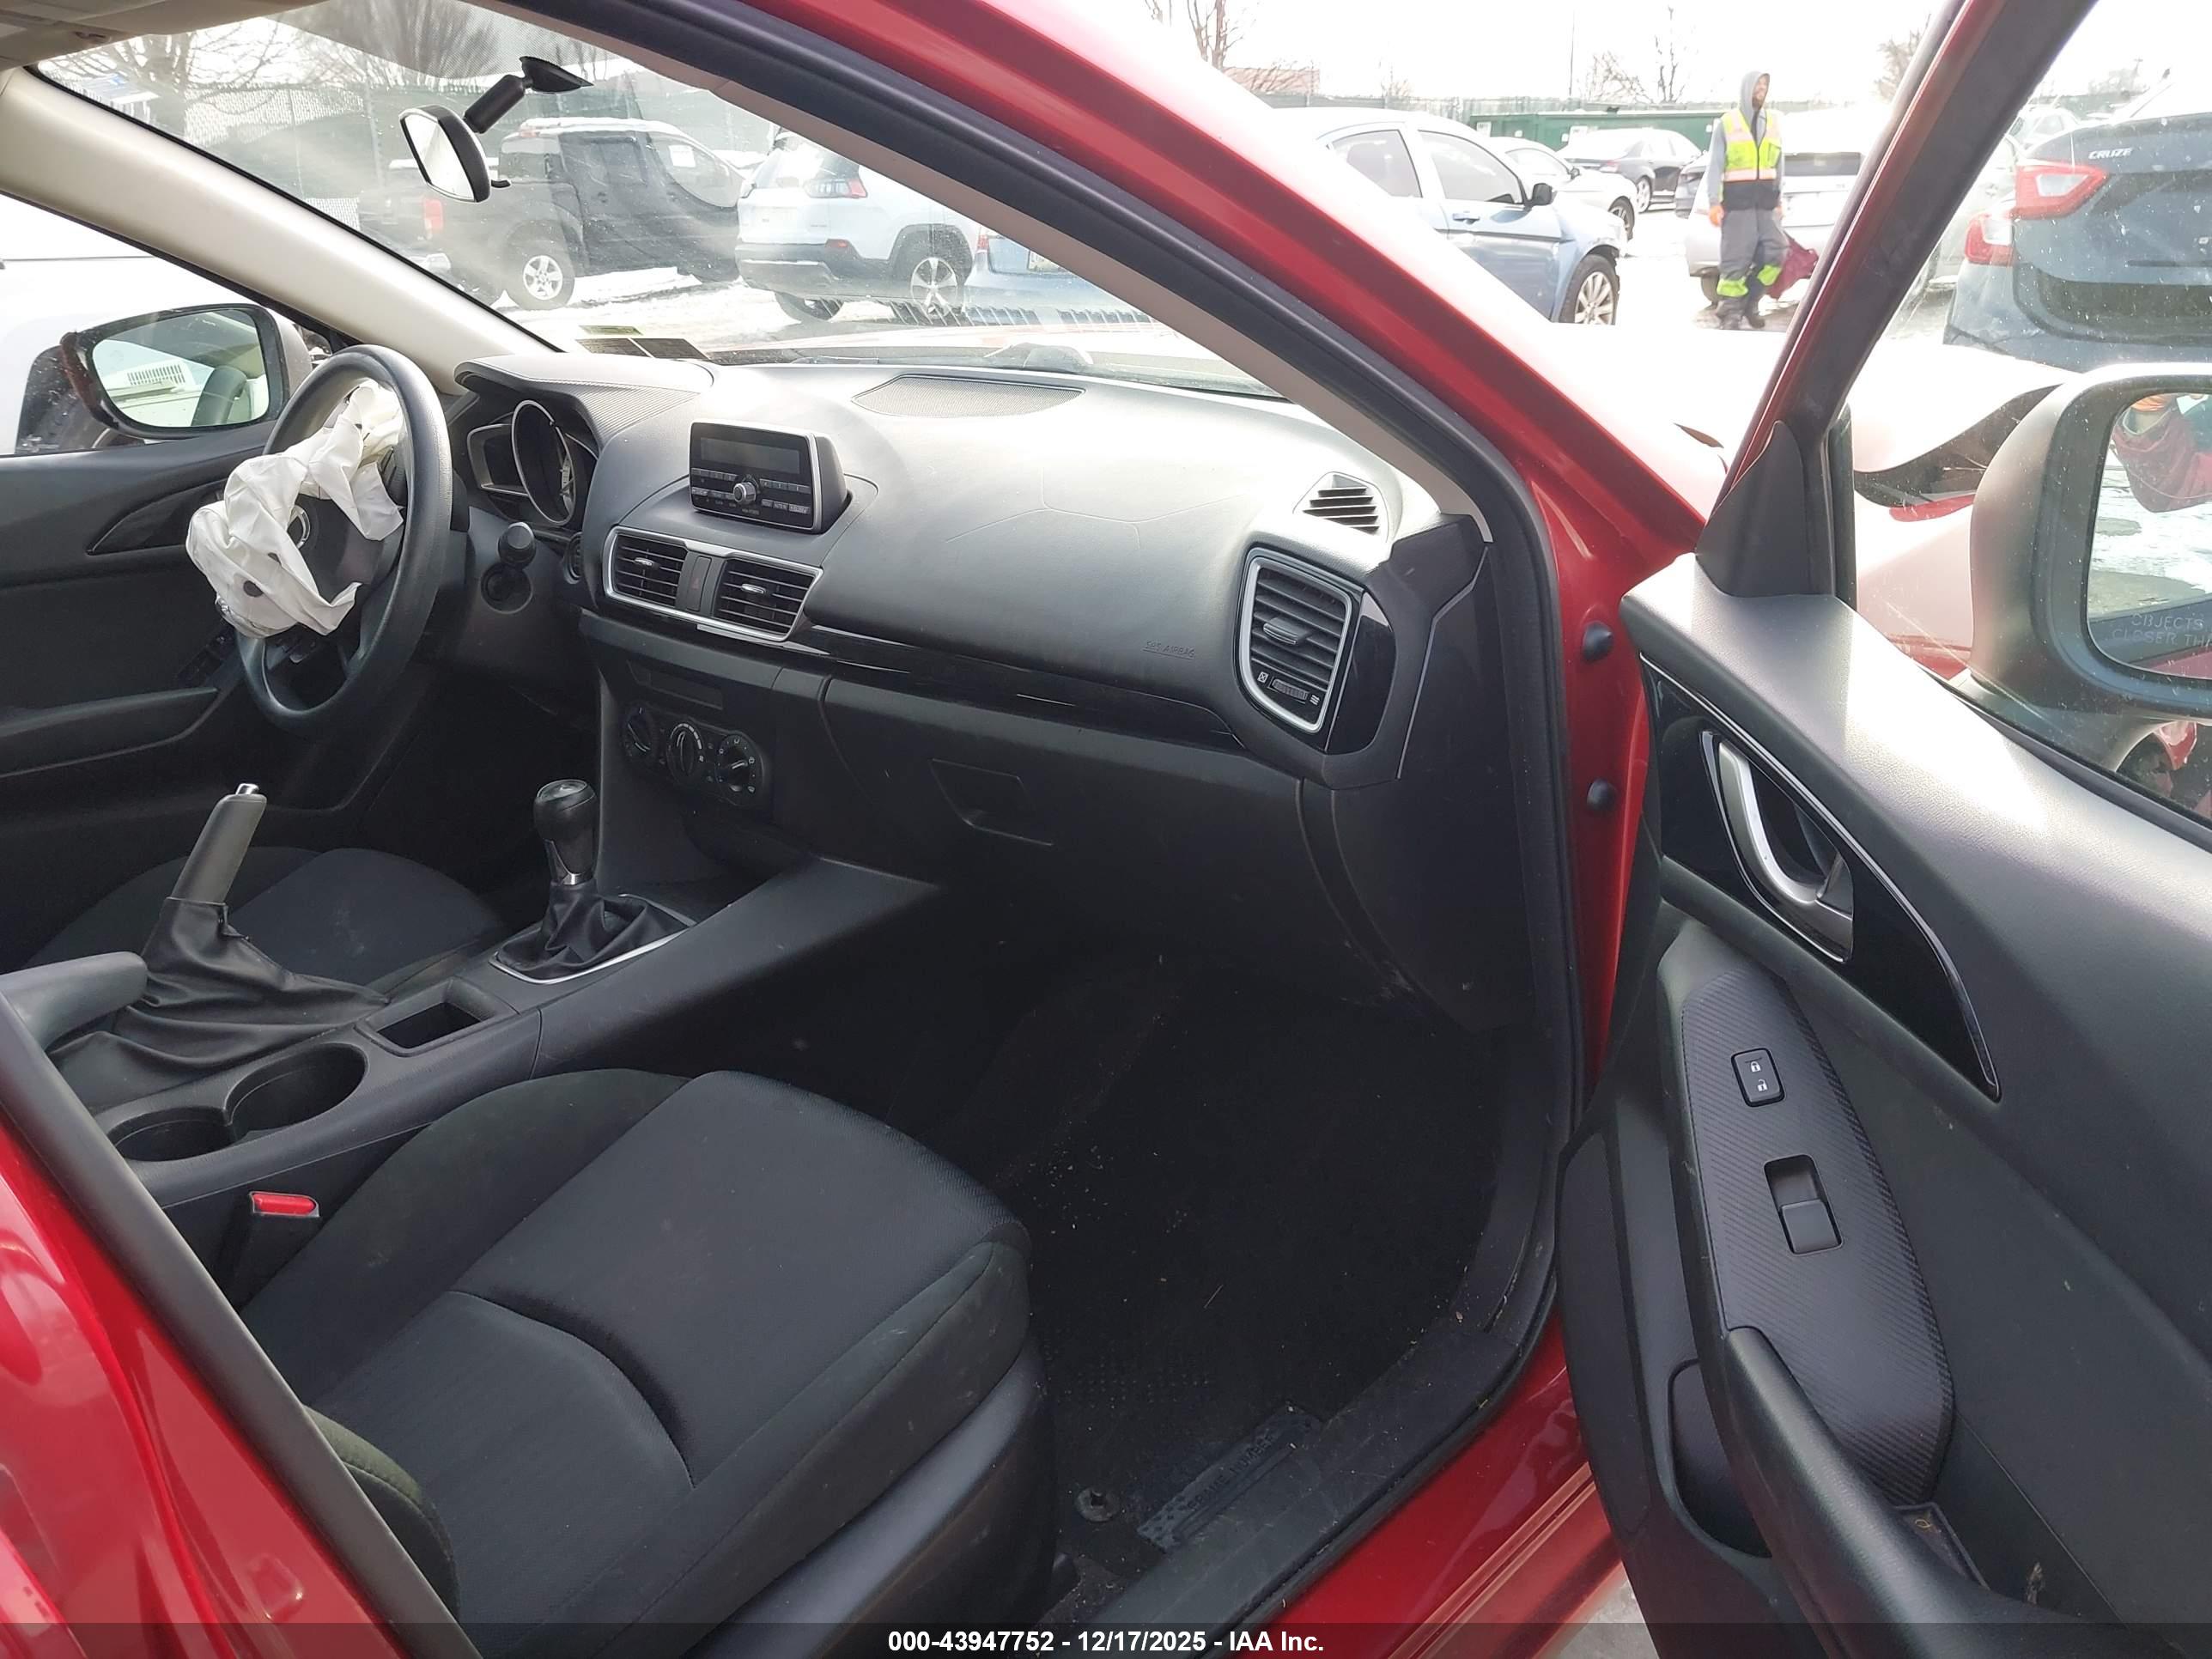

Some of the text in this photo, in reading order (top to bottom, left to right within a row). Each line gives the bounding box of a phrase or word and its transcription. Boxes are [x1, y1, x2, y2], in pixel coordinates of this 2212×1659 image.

[2087, 147, 2133, 160] CRUZE
[2131, 612, 2204, 630] OBJECTS
[2112, 628, 2178, 646] CLOSER
